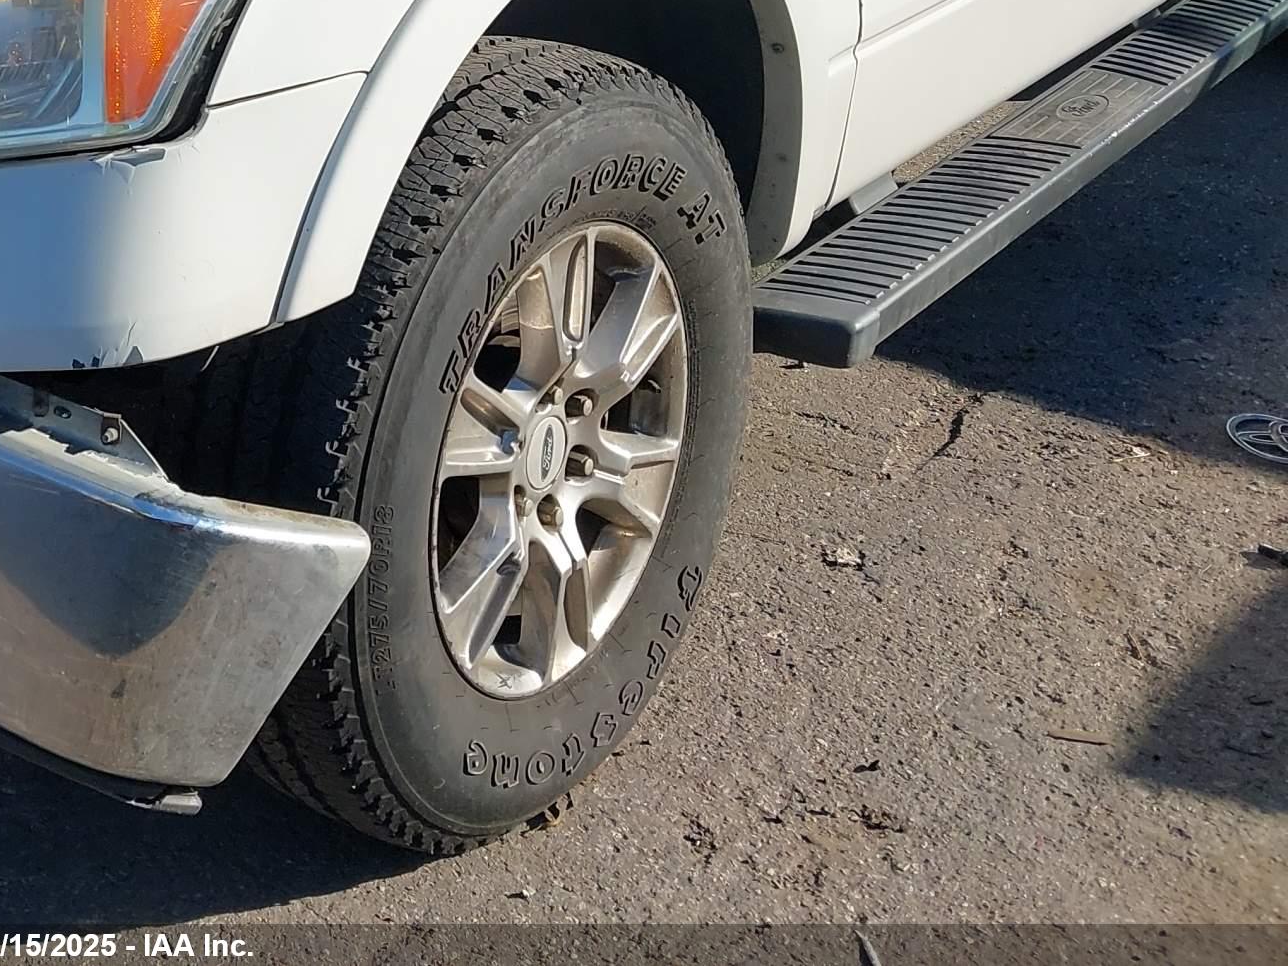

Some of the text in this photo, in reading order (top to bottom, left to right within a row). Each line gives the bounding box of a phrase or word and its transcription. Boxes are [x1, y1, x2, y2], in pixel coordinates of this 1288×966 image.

[439, 152, 687, 395] TRANSFORCE
[675, 190, 727, 245] AT
[542, 436, 553, 471] Ford
